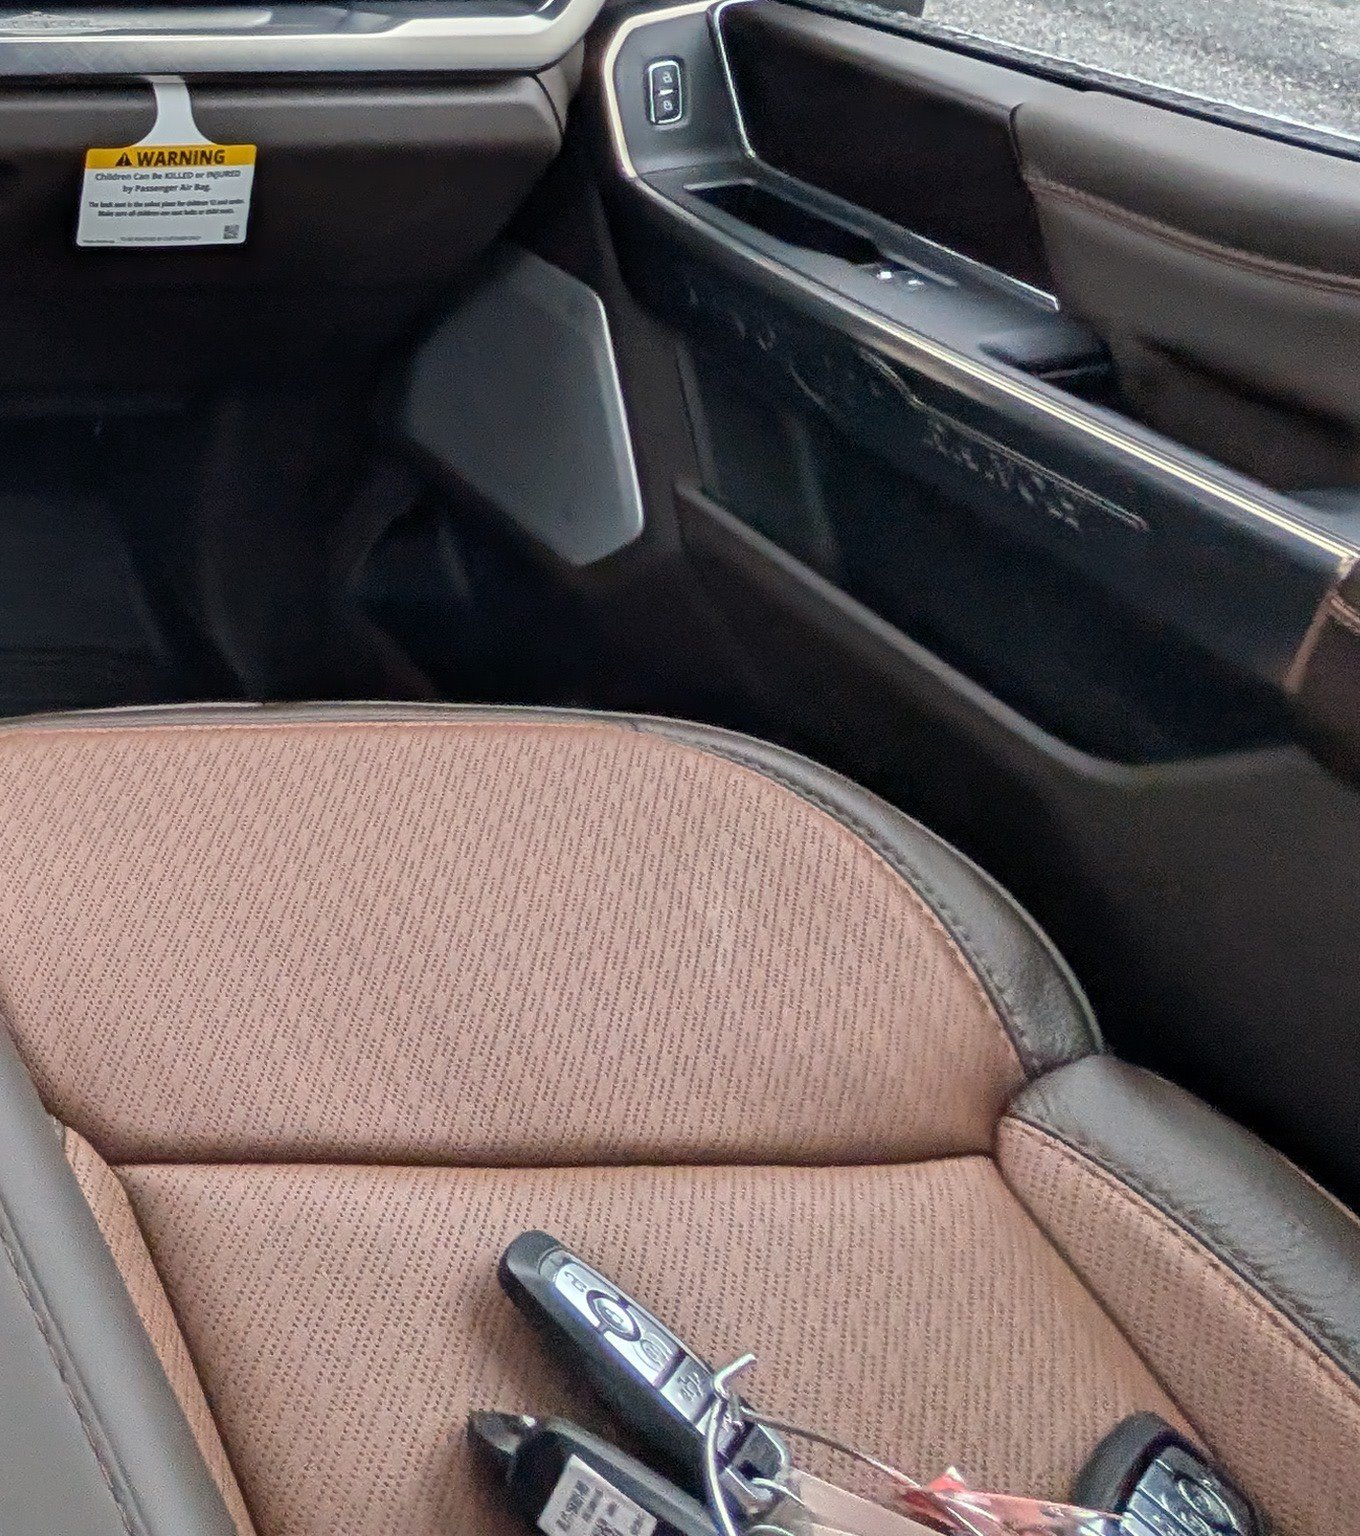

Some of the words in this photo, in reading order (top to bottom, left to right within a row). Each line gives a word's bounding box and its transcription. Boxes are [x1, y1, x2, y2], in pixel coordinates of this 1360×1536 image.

[136, 149, 226, 168] WARNING
[95, 171, 132, 181] Children
[134, 171, 150, 181] Can
[152, 171, 163, 180] Be
[165, 170, 193, 180] KILLED
[206, 170, 241, 180] INJURED
[122, 184, 133, 194] by
[135, 184, 178, 194] Passenger
[180, 183, 192, 192] Air
[194, 183, 211, 193] Bag.
